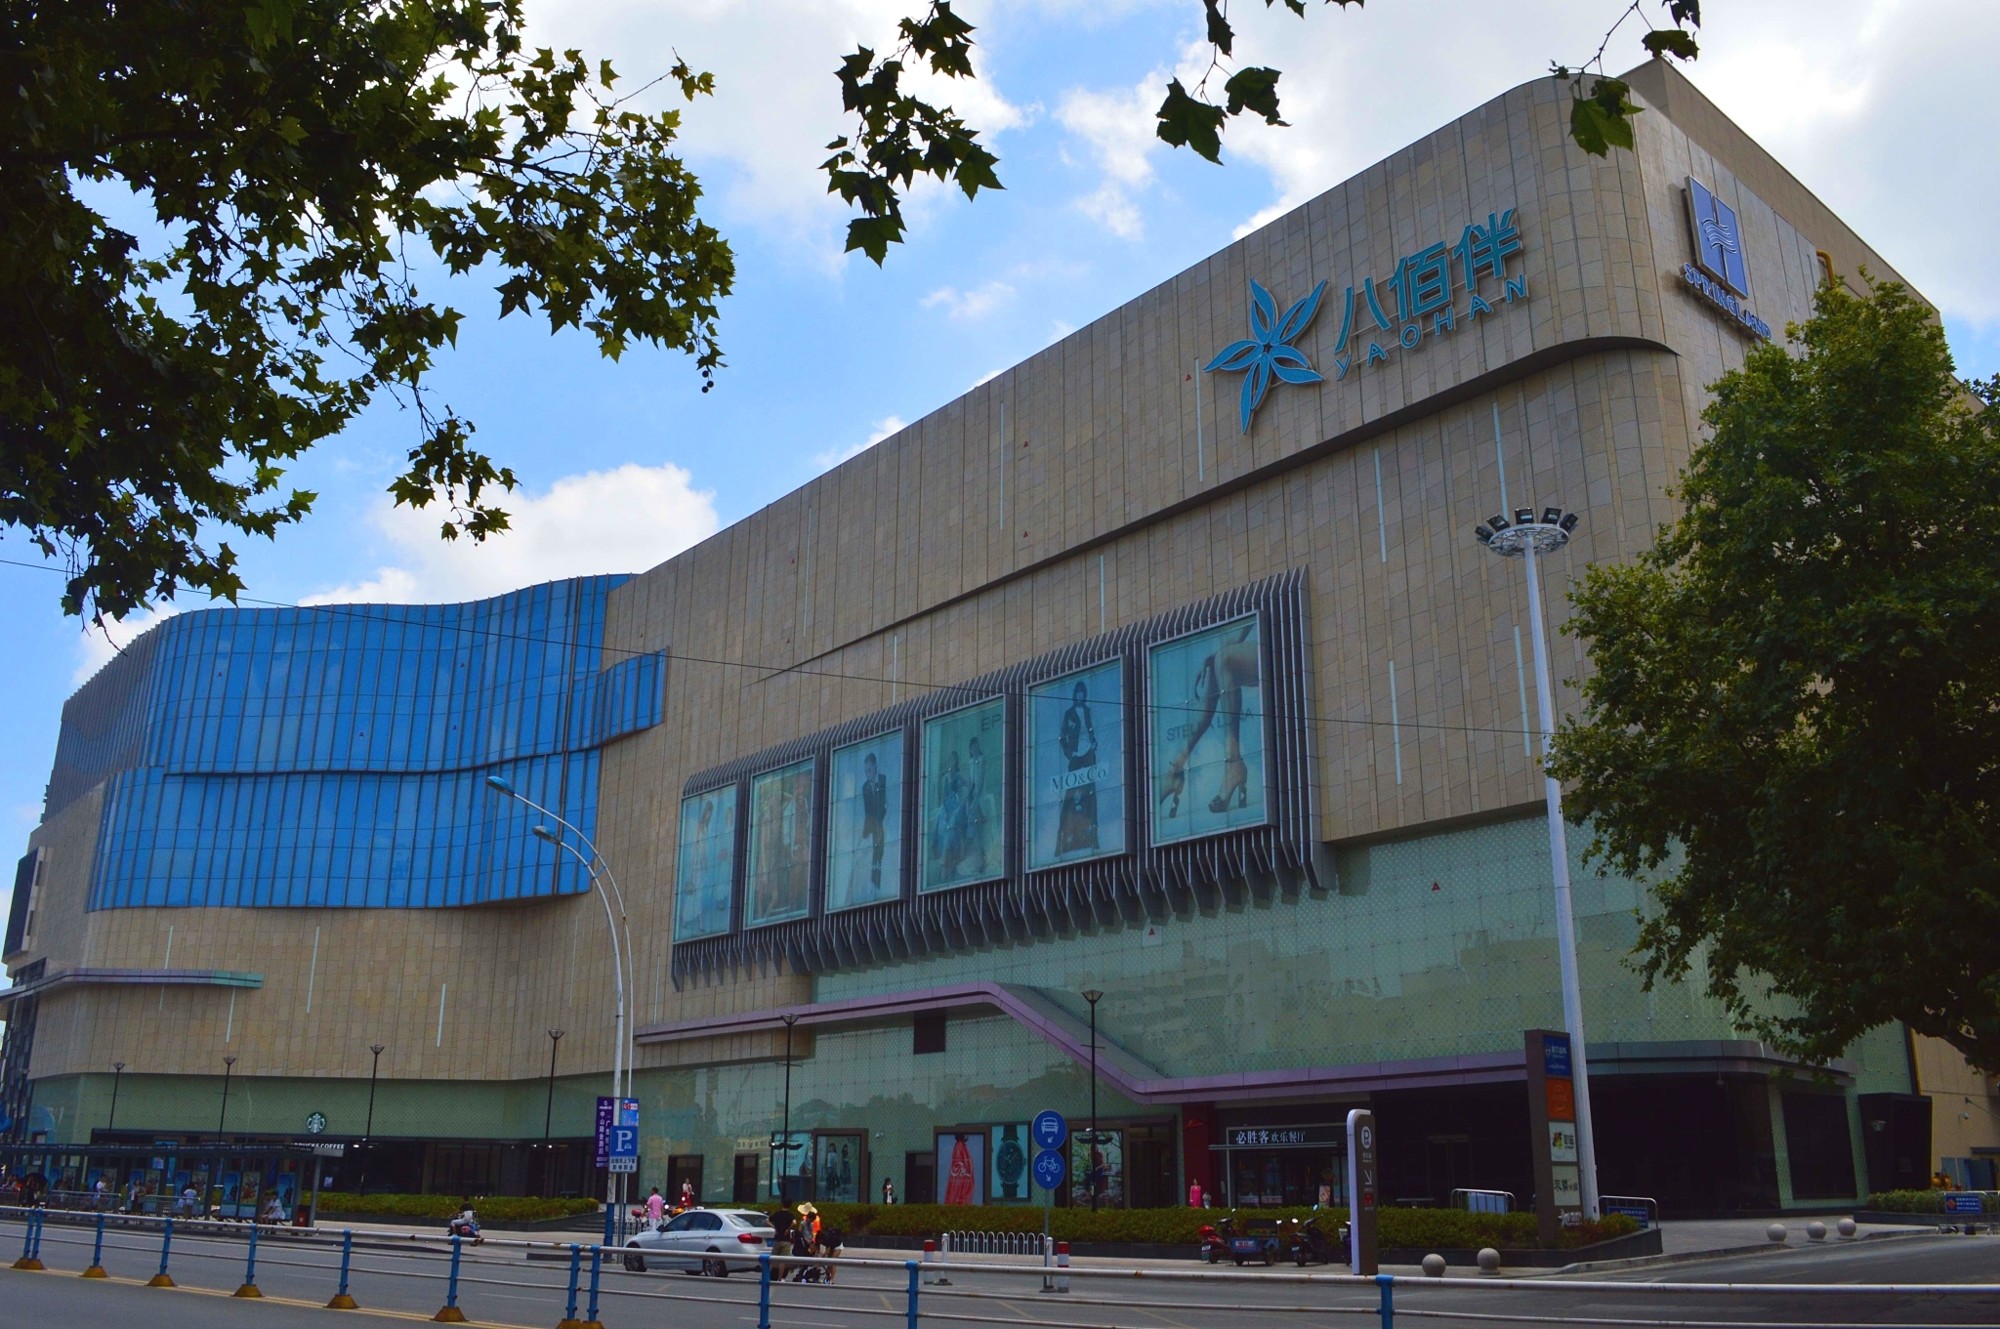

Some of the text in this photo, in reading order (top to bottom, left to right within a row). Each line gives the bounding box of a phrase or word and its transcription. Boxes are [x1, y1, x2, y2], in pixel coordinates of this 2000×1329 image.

[1334, 207, 1522, 354] 八佰伴
[1684, 262, 1772, 340] SPRINGLAND
[1335, 273, 1528, 382] YAOHAN
[616, 1130, 632, 1152] P
[1236, 1129, 1269, 1144] 必胜客
